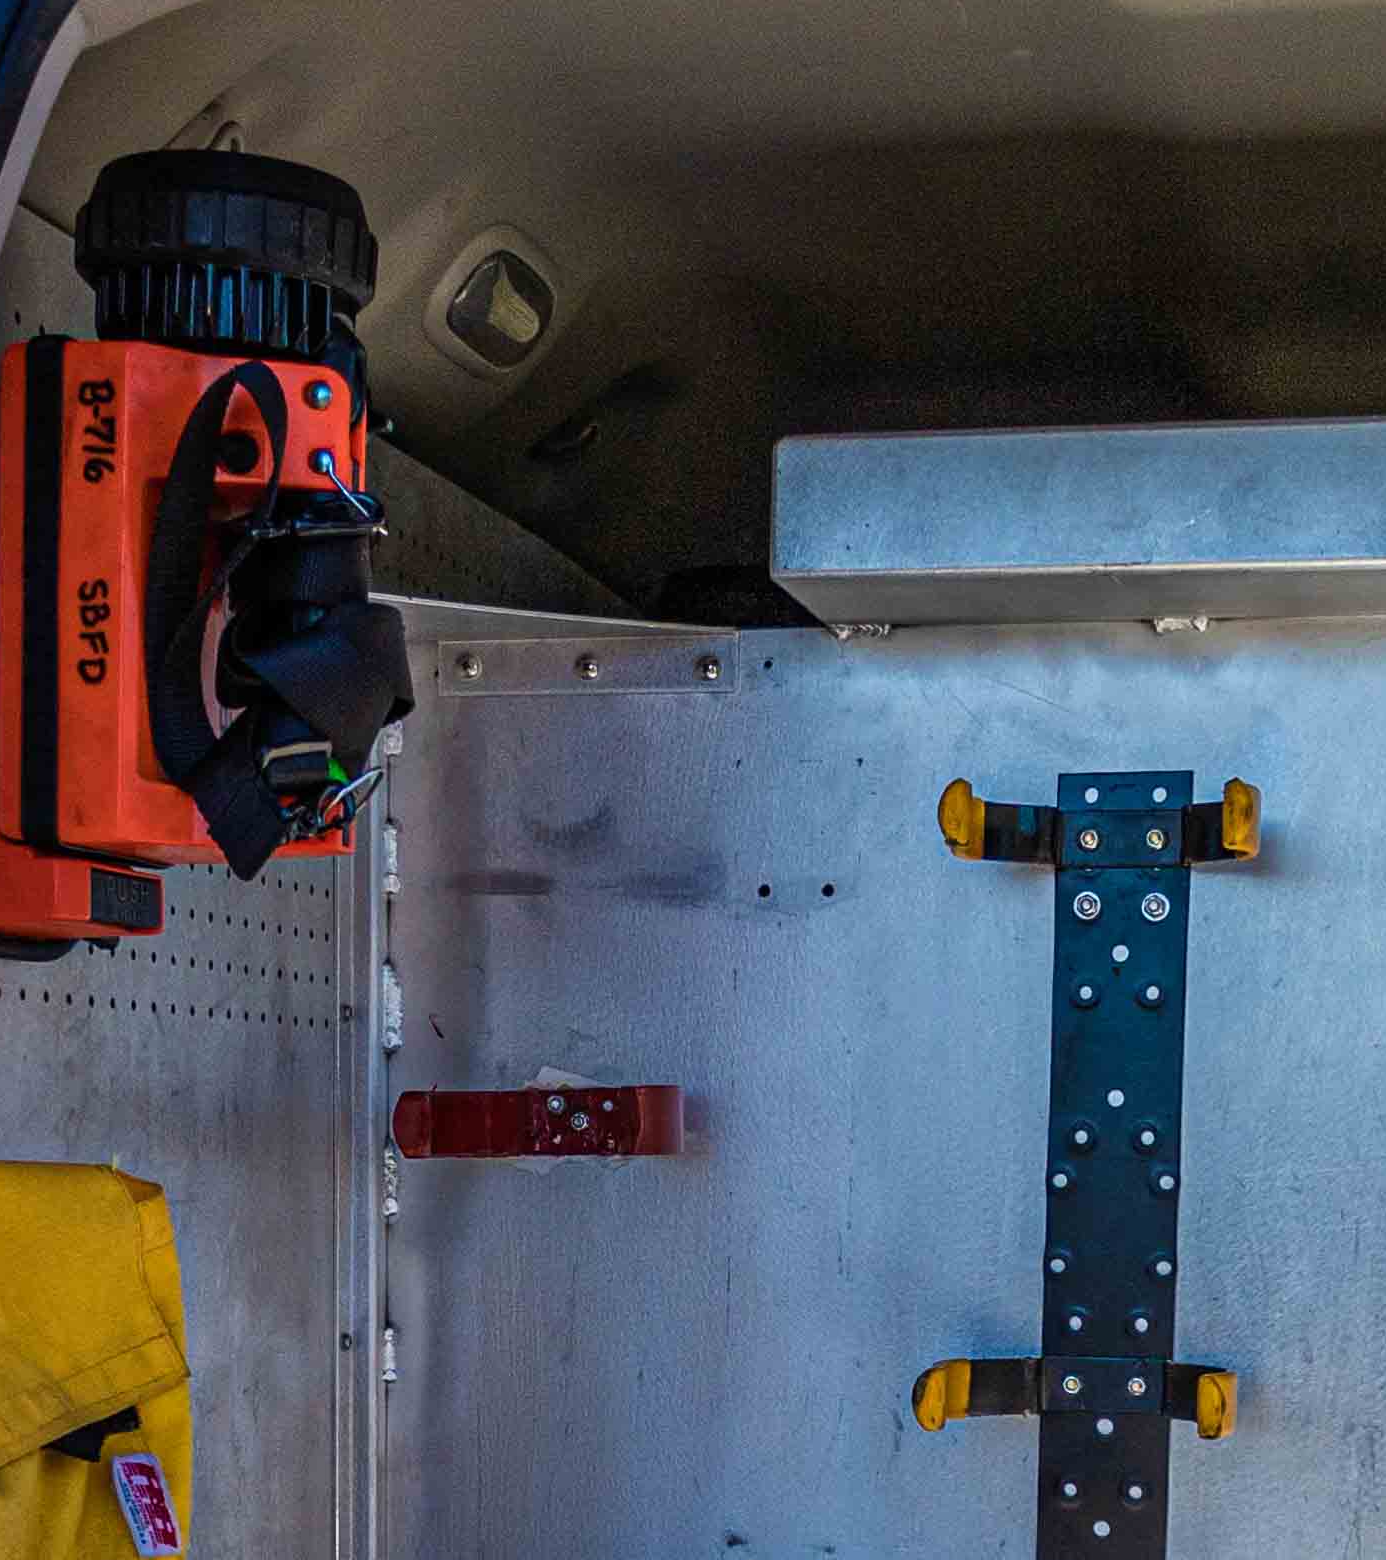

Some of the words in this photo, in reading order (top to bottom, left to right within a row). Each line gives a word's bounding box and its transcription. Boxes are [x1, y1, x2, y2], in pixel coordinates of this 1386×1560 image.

[78, 377, 117, 484] B-716
[77, 578, 111, 684] SBFD
[105, 874, 151, 905] PUSH
